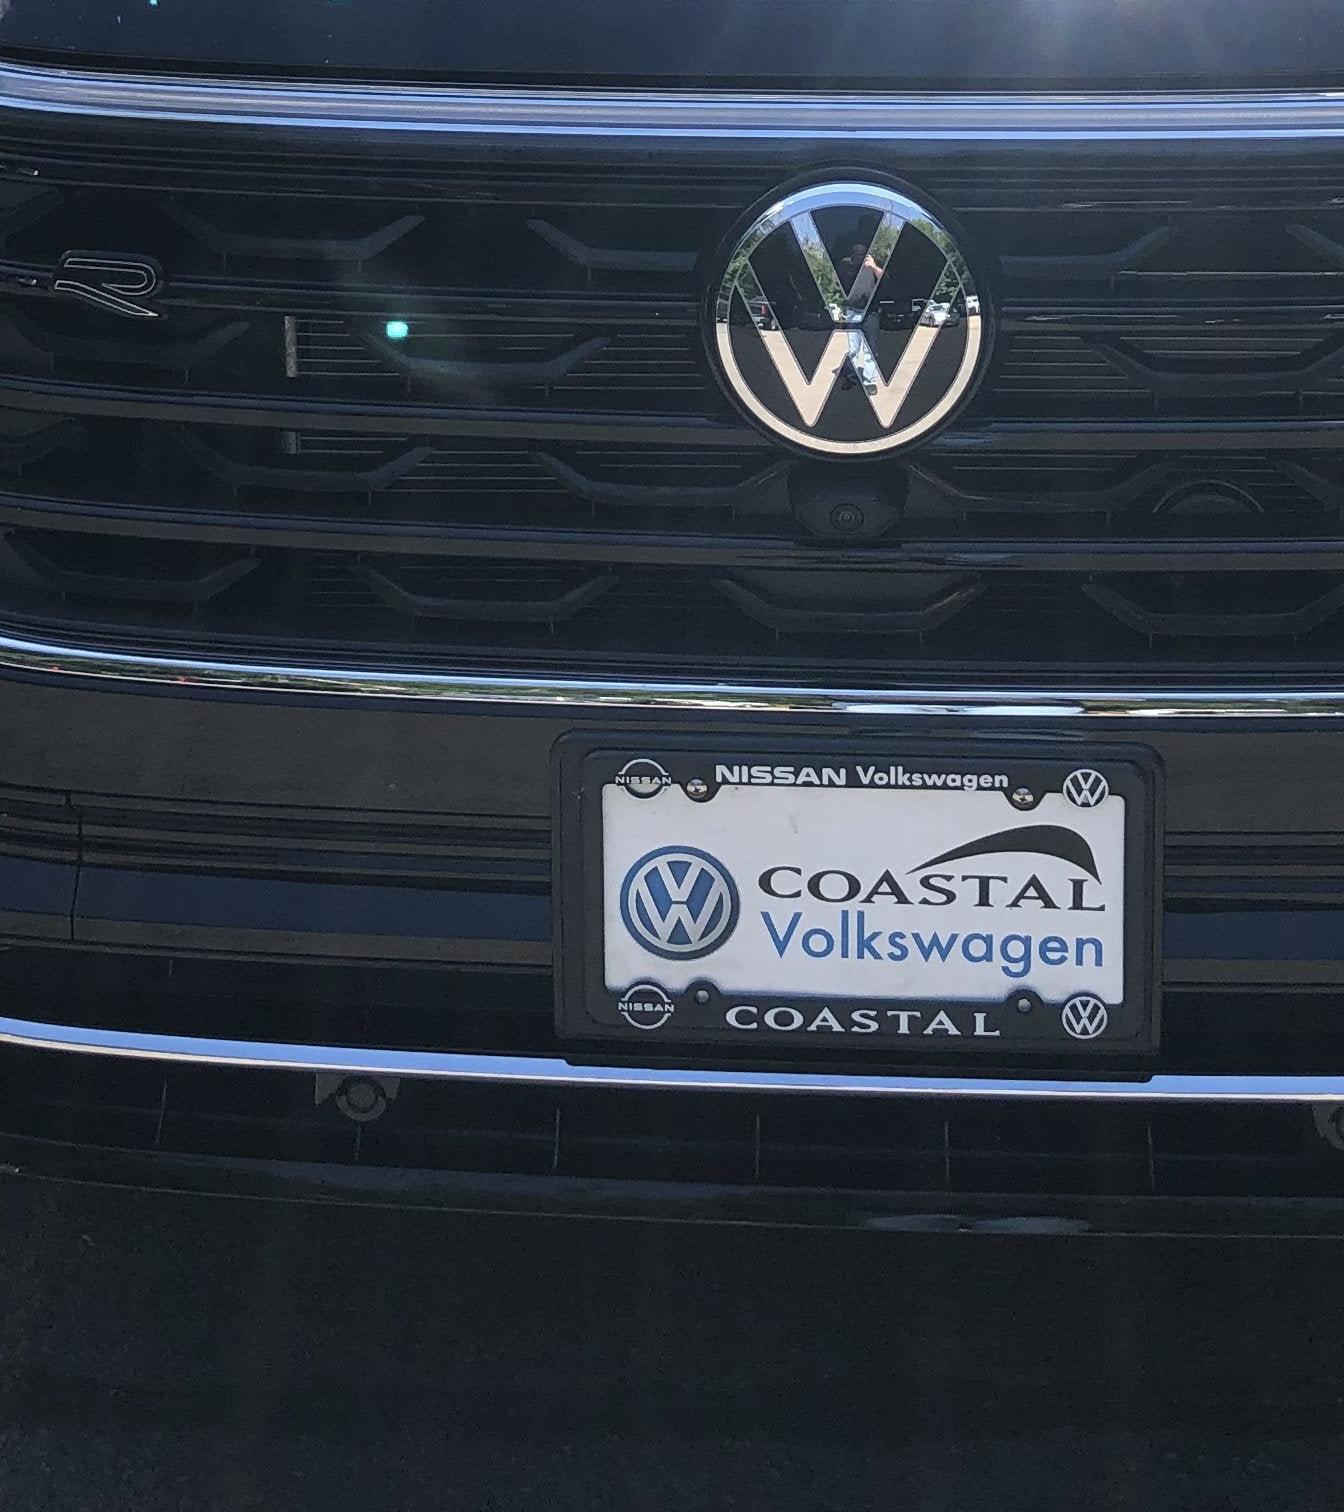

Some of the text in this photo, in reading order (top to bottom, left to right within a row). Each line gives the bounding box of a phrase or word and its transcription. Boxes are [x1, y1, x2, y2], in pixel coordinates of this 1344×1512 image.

[732, 204, 965, 430] VW
[615, 775, 672, 786] NISSAN
[714, 764, 1009, 791] NISSAN Volkswagen
[1064, 770, 1108, 808] VW
[630, 854, 731, 952] VW
[757, 865, 1106, 912] COASTAL
[760, 909, 1104, 978] Volkswagen
[618, 1001, 674, 1014] NISSAN
[725, 1005, 1001, 1037] COASTAL
[1063, 997, 1107, 1038] VW
